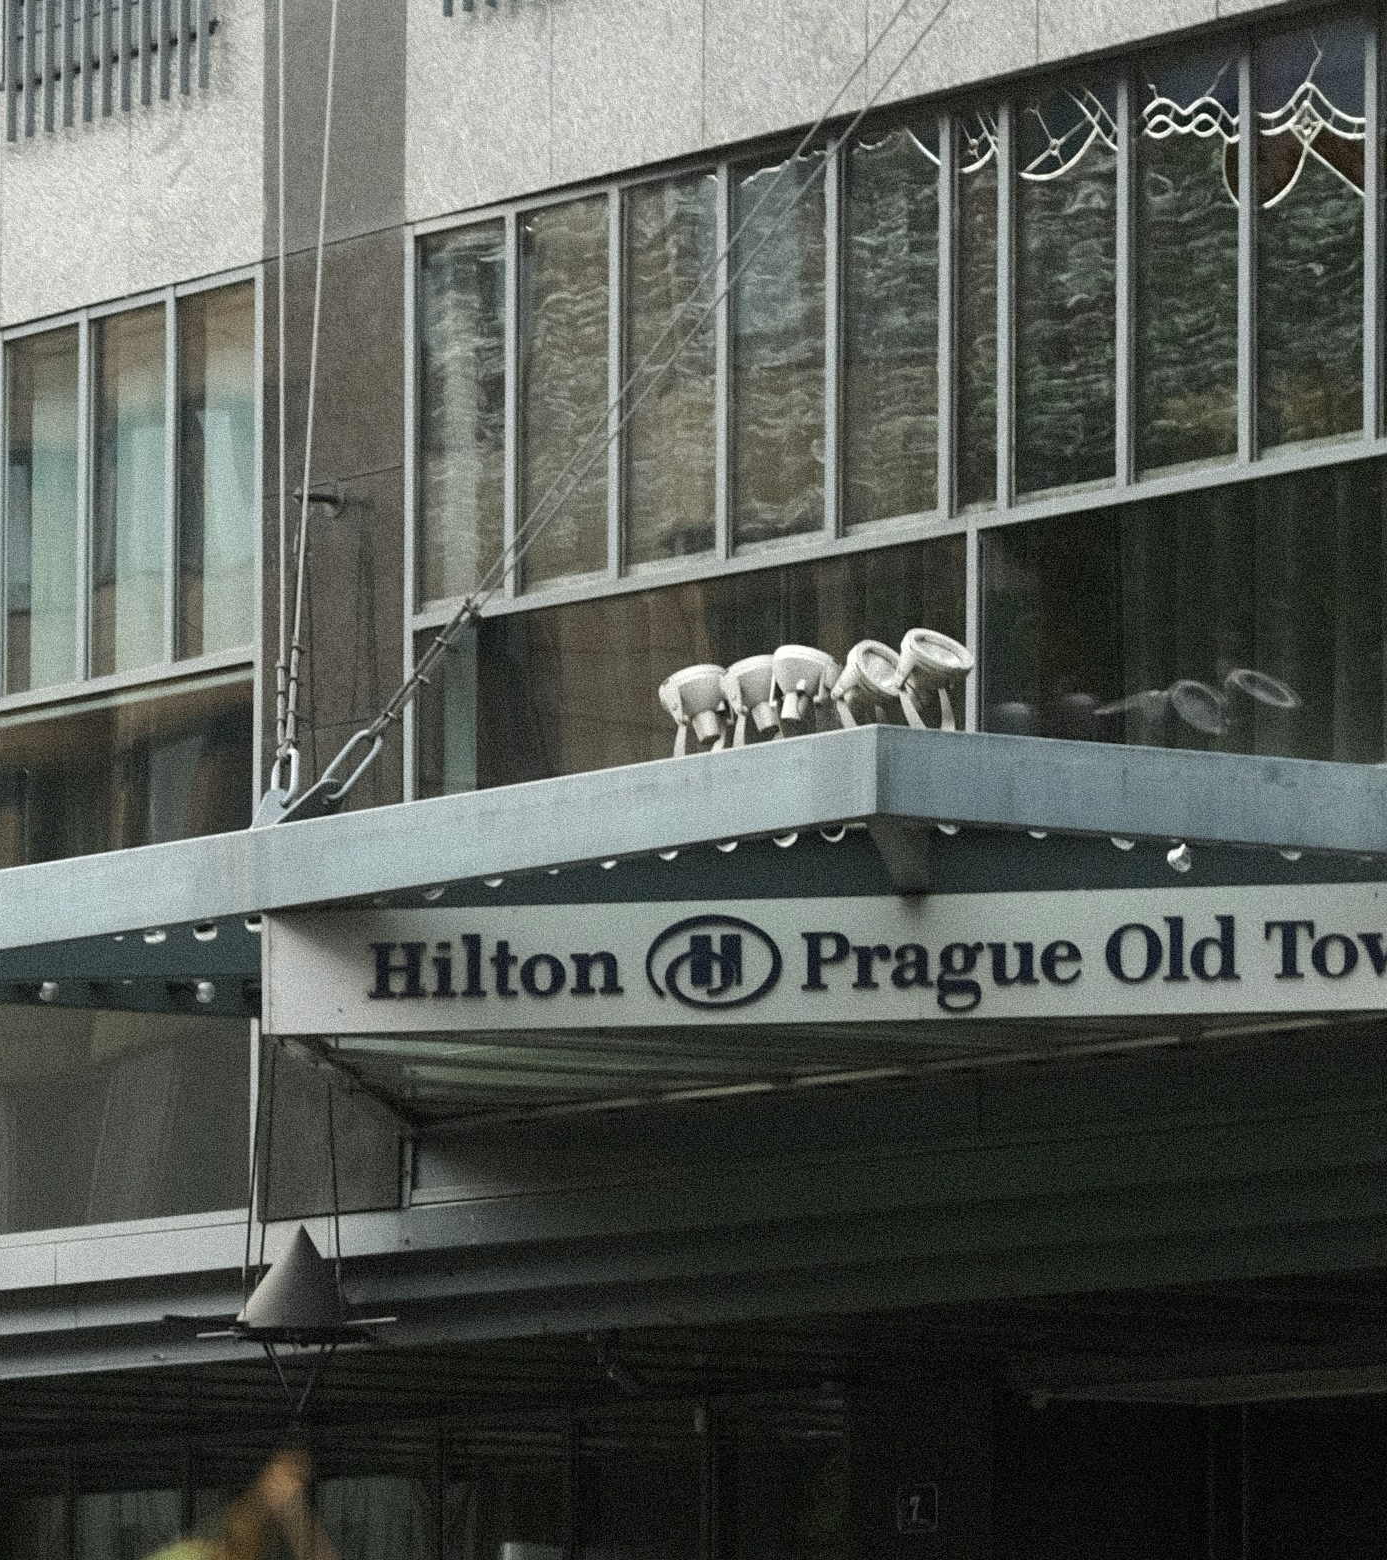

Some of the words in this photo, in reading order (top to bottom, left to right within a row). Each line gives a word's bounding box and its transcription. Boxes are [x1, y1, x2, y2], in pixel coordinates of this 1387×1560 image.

[368, 933, 625, 999] Hilton
[801, 931, 1083, 1013] Prague
[1105, 915, 1241, 984] Old
